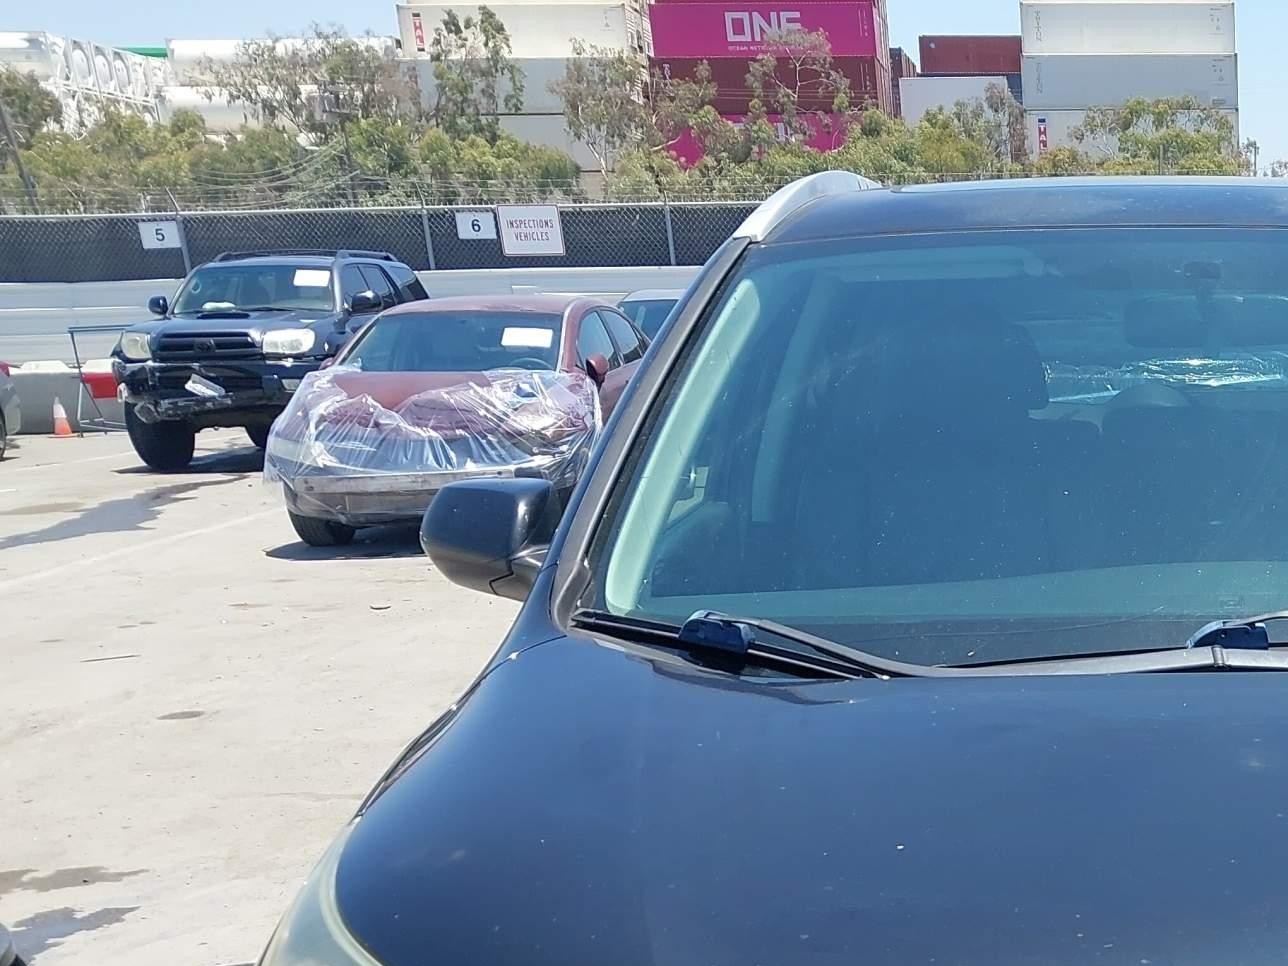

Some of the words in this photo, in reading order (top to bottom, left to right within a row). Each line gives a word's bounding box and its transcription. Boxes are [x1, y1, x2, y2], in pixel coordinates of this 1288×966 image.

[724, 11, 801, 42] ONE
[471, 218, 482, 233] 6
[506, 218, 554, 229] INSPECTIONS
[155, 228, 165, 242] 5
[514, 231, 550, 241] VEHICLES
